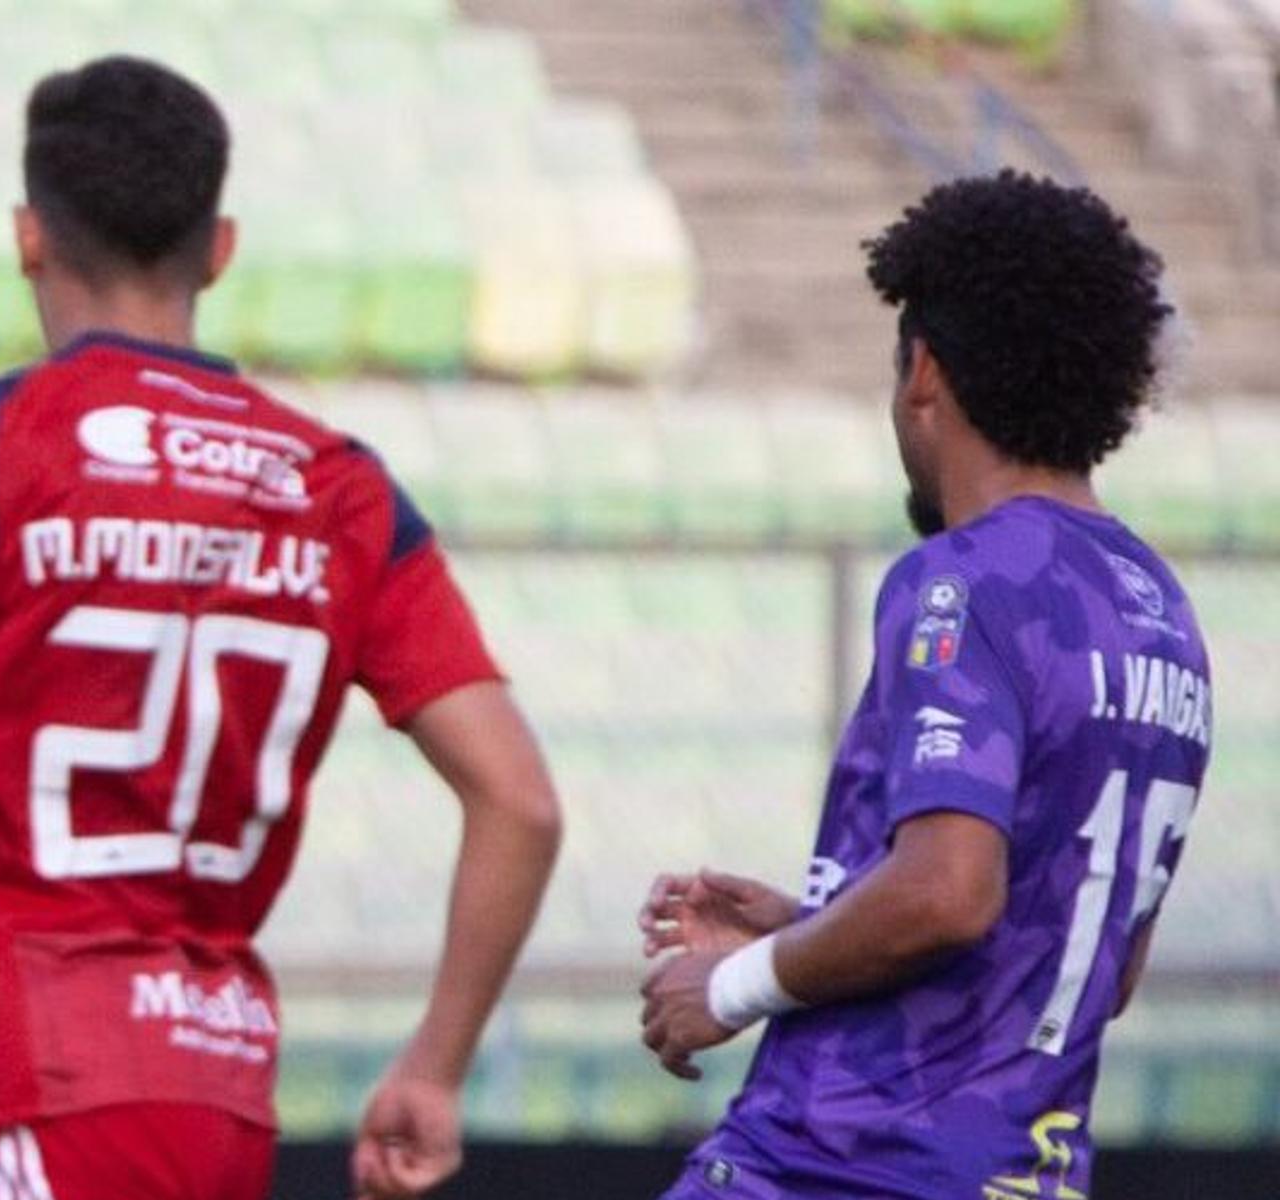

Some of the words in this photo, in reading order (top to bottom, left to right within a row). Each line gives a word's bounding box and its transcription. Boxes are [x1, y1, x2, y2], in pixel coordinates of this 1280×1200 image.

[30, 606, 330, 882] 20
[1091, 650, 1117, 719] J.
[1125, 652, 1214, 748] VARGA
